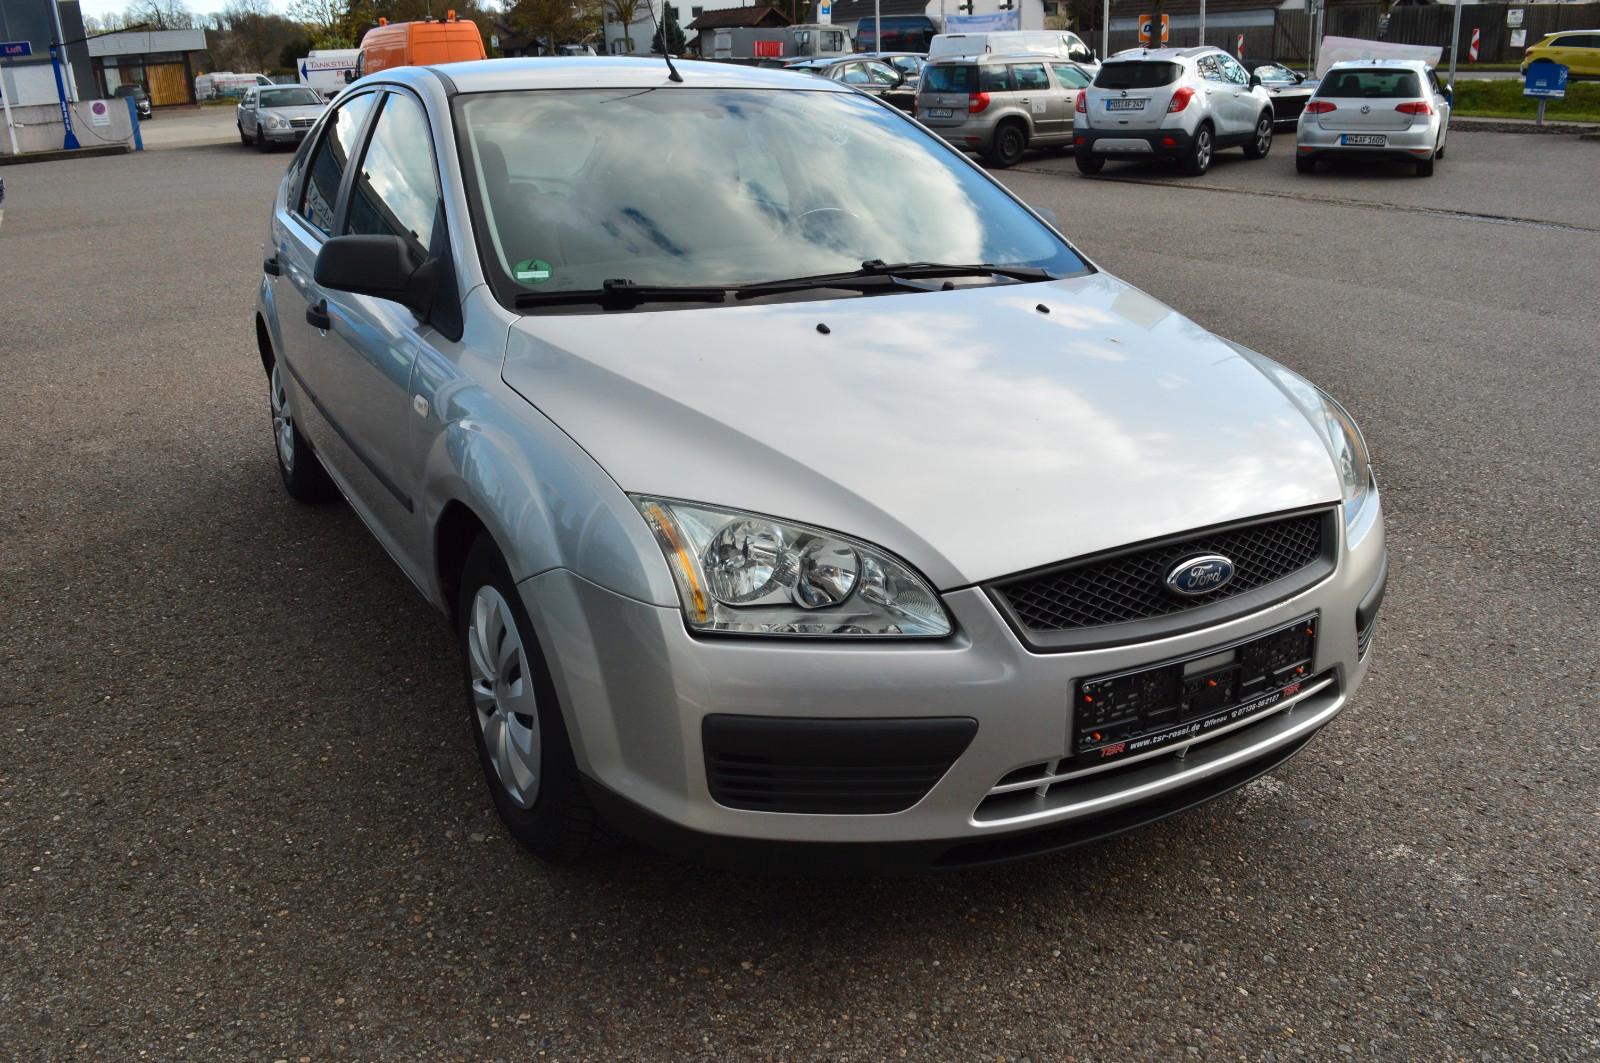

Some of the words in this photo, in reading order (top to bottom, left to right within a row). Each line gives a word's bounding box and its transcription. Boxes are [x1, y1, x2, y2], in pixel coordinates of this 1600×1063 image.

[309, 61, 355, 69] TANKSTELL
[1187, 564, 1222, 588] Ford
[1204, 715, 1228, 727] Offenau
